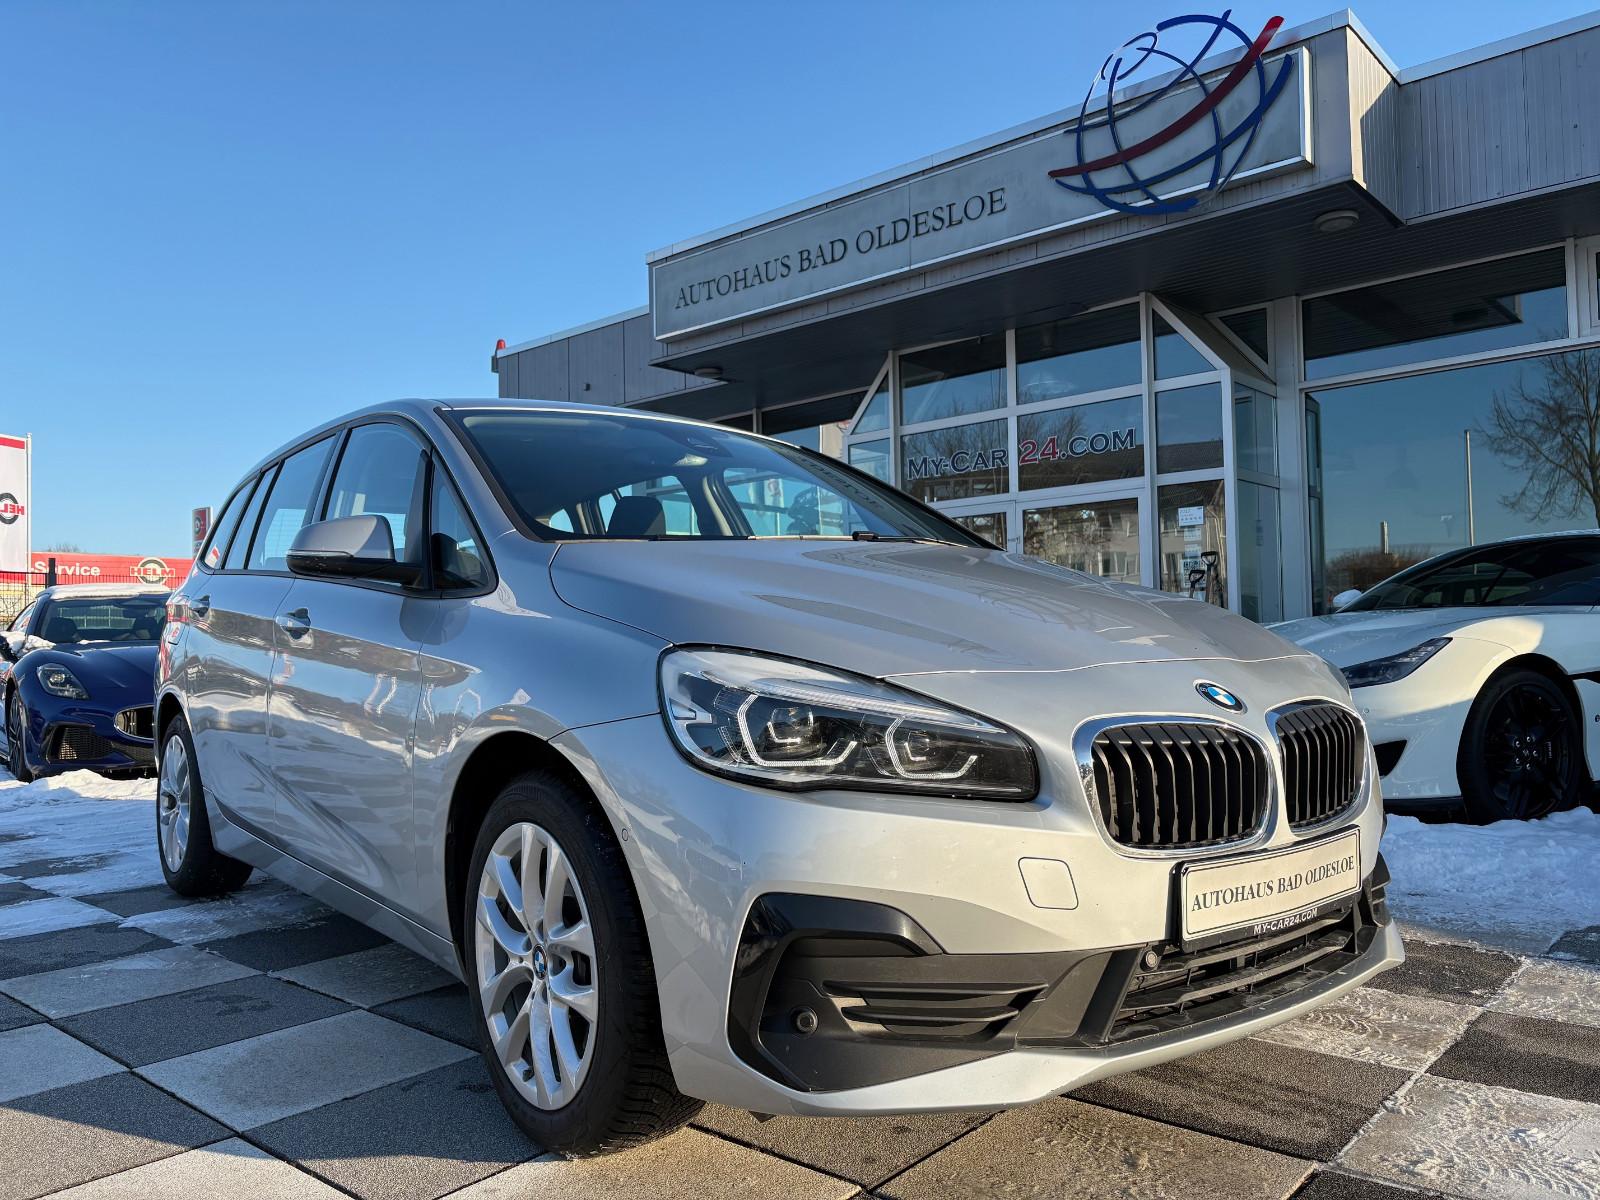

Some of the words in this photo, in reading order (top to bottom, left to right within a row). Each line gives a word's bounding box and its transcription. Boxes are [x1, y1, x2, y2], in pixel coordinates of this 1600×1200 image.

[675, 254, 791, 310] AUTOHAUS
[798, 238, 847, 273] BAD
[855, 187, 1007, 254] OLDESLOE
[130, 566, 175, 577] HELM
[1191, 880, 1274, 912] AUTOHAUS
[1277, 873, 1302, 894] BAD
[1305, 855, 1354, 885] OLDESLOE
[1253, 908, 1318, 935] MY-CAR24.COM
